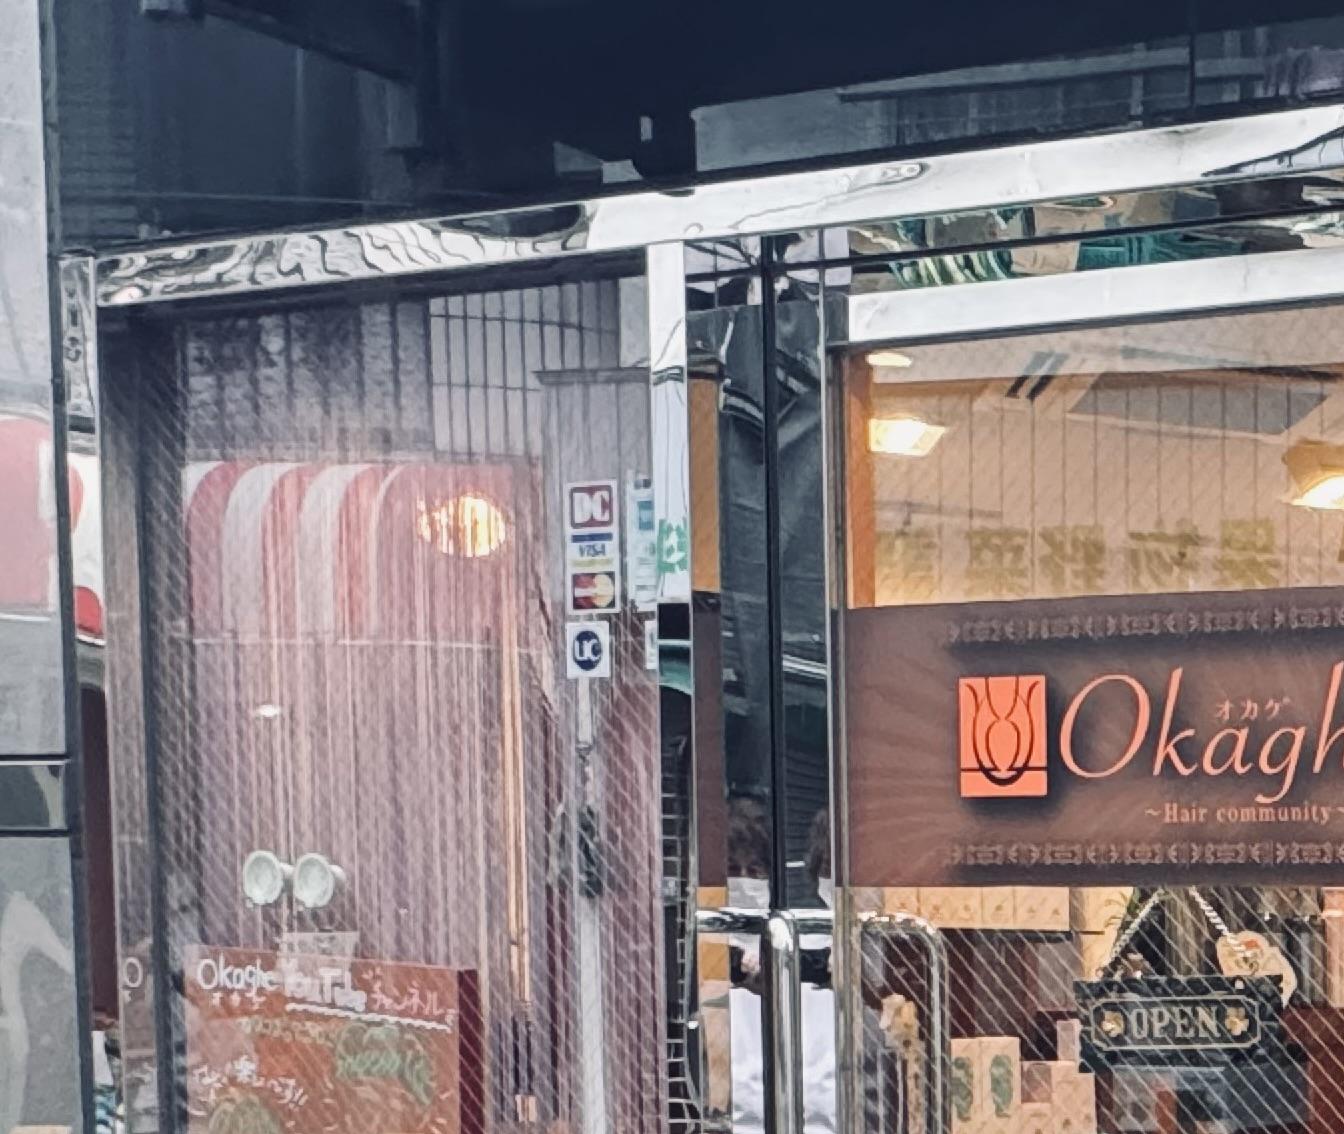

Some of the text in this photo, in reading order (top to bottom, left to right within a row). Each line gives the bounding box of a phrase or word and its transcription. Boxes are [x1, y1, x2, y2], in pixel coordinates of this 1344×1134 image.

[1214, 697, 1290, 721] オカゲ
[1131, 1006, 1221, 1039] OPEN
